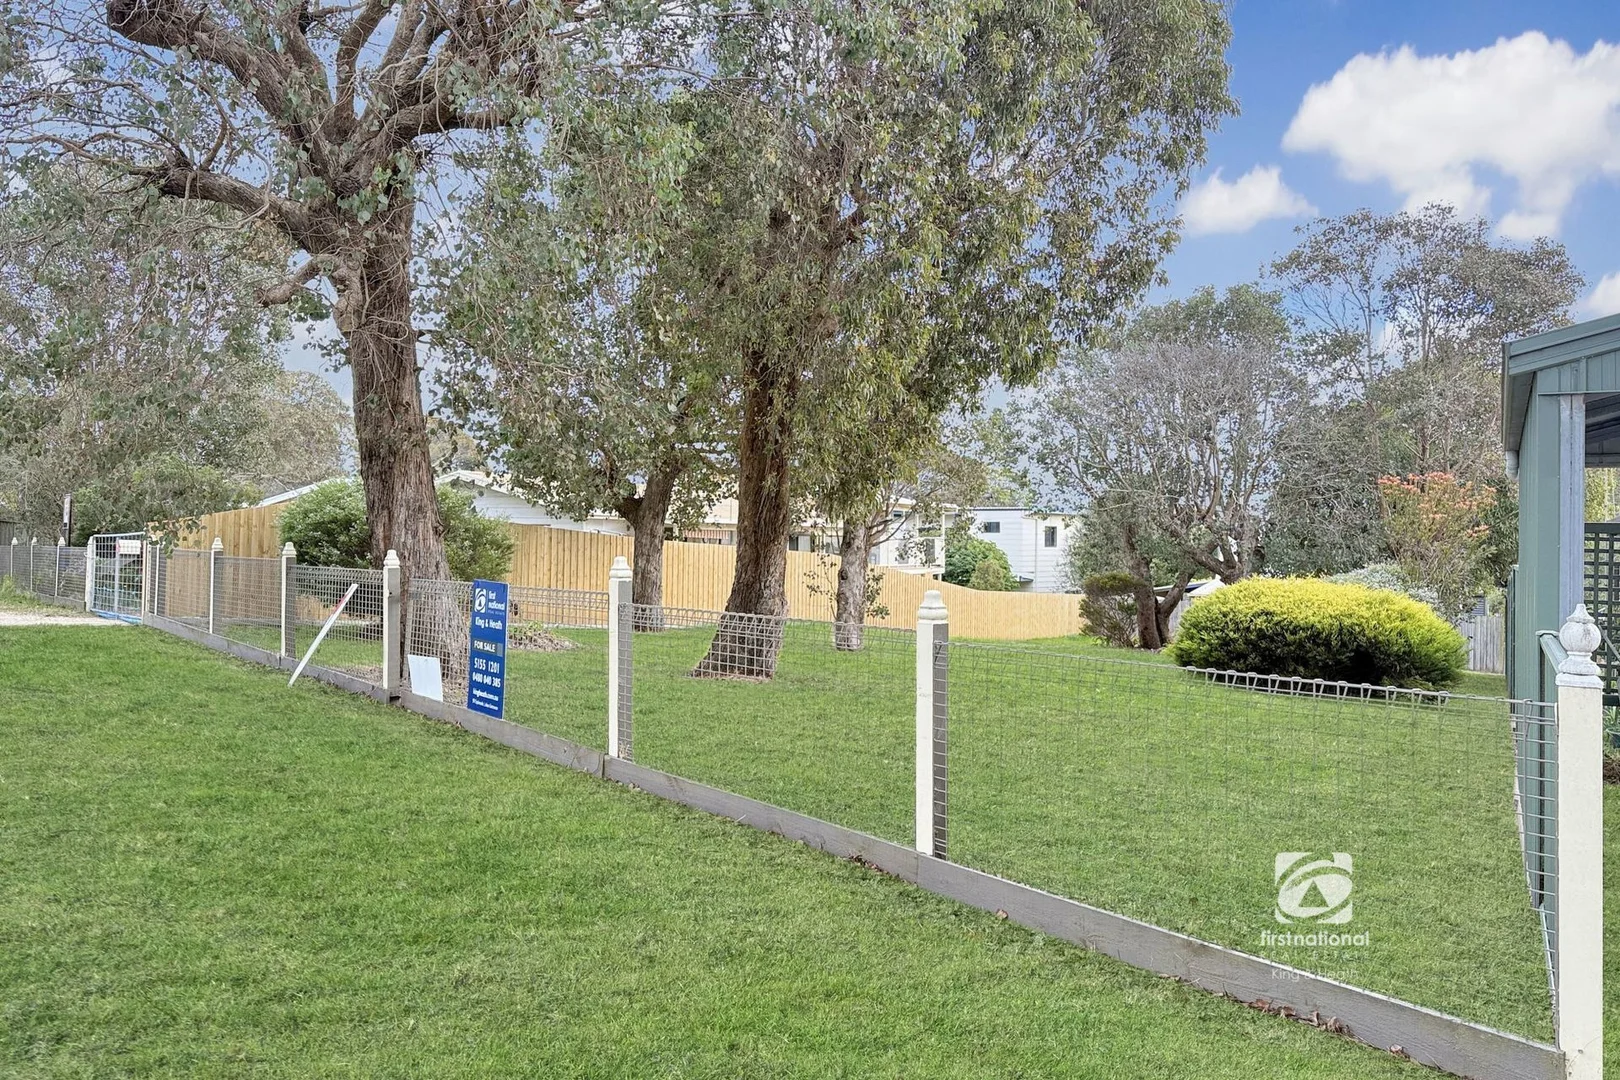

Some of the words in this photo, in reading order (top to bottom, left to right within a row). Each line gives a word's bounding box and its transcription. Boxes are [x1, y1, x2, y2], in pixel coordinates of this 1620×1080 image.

[474, 640, 483, 650] FOR
[484, 641, 496, 653] SALE
[474, 657, 486, 671] 5155
